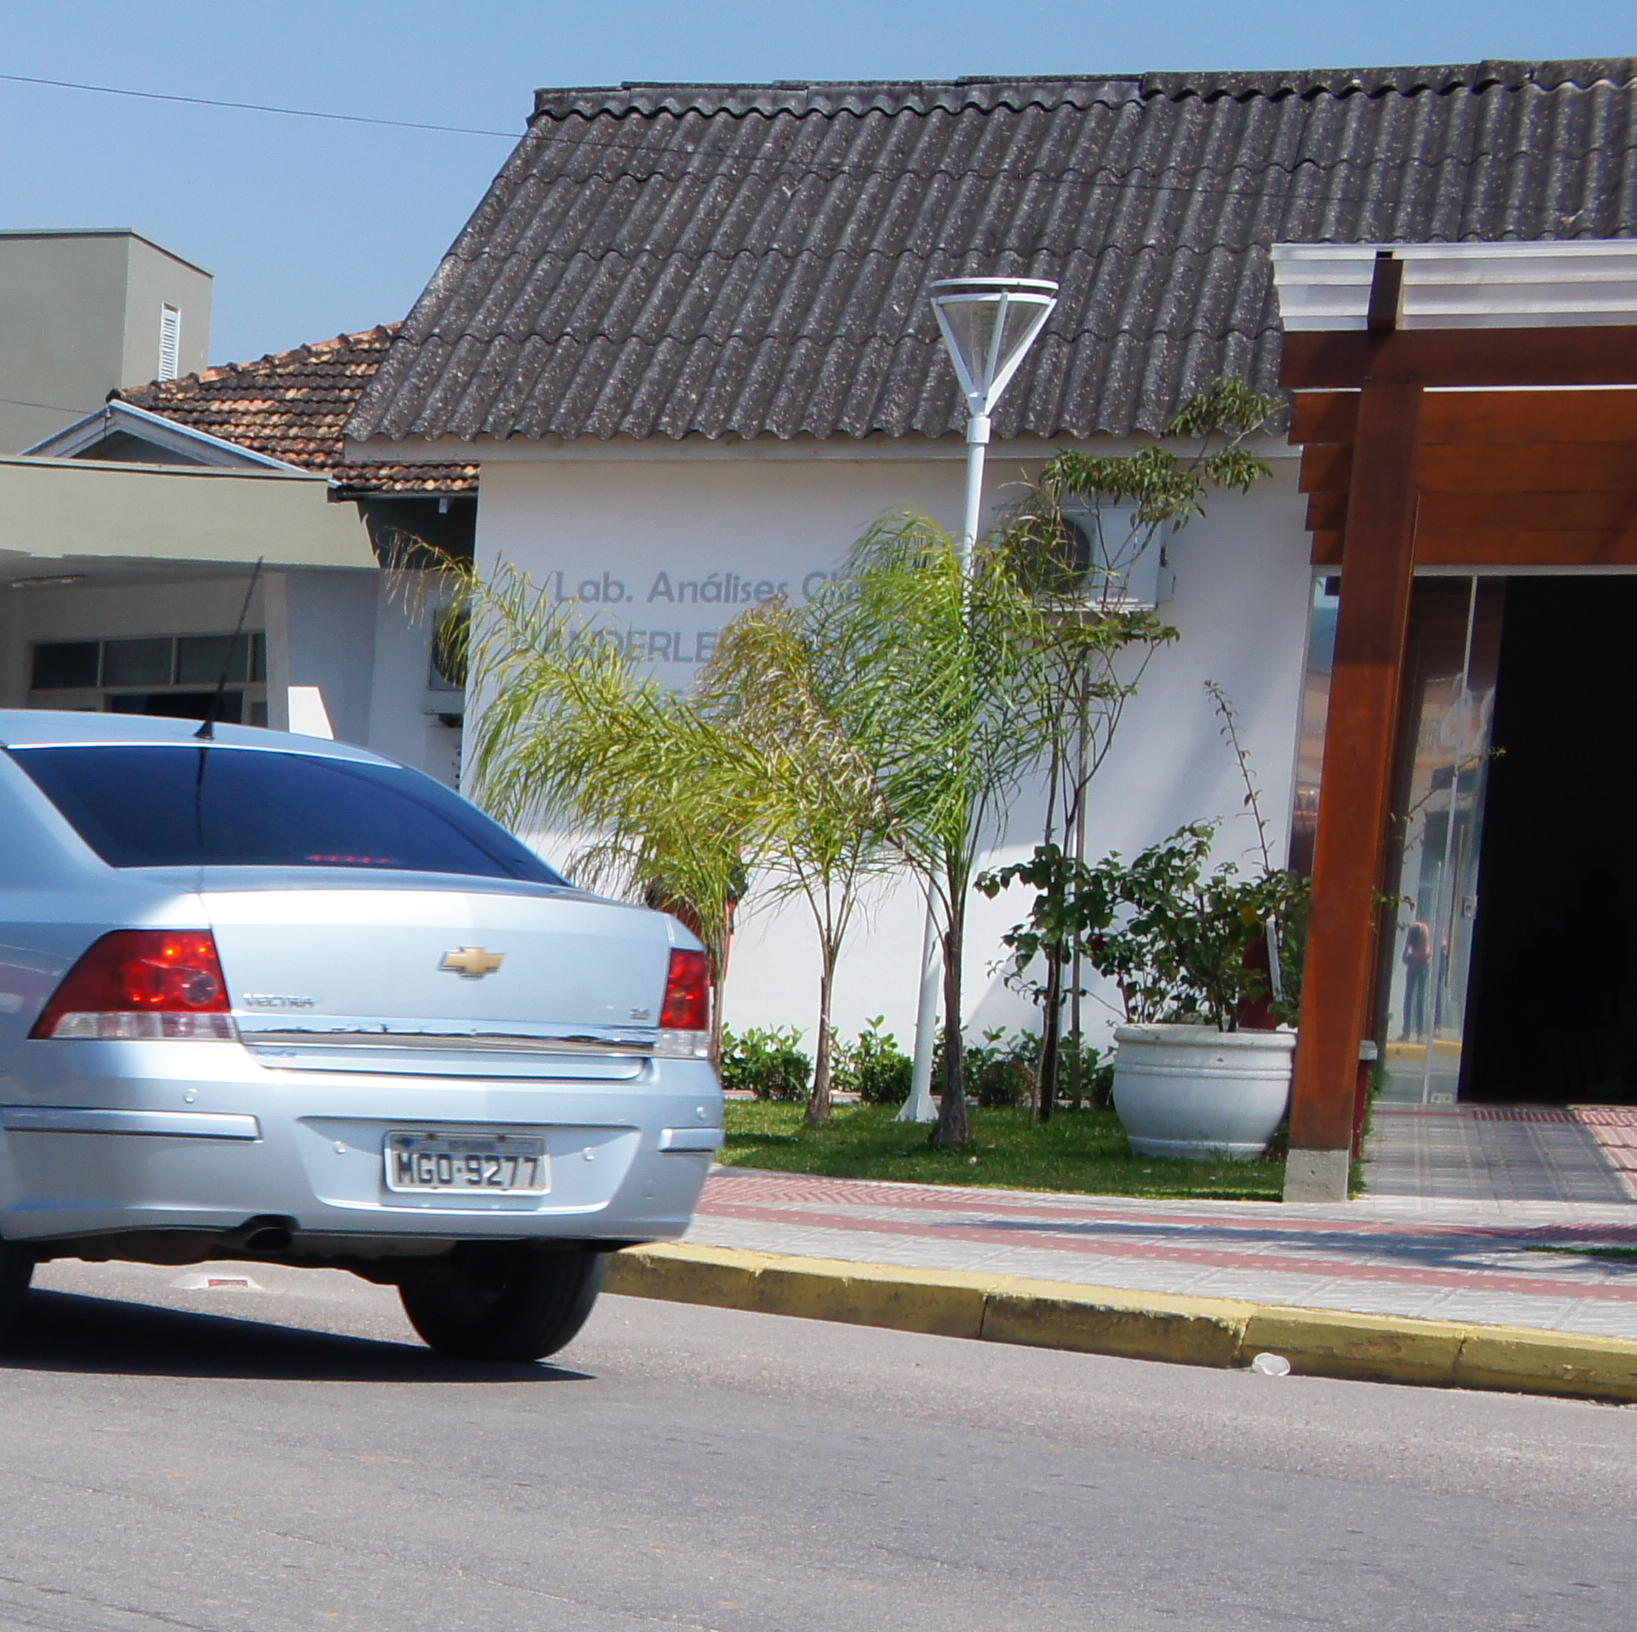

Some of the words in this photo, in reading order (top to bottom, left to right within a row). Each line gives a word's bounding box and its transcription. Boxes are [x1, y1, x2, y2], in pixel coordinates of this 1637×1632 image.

[554, 571, 633, 603] Lab.
[647, 571, 789, 604] Análises
[243, 993, 315, 1009] VECTRA
